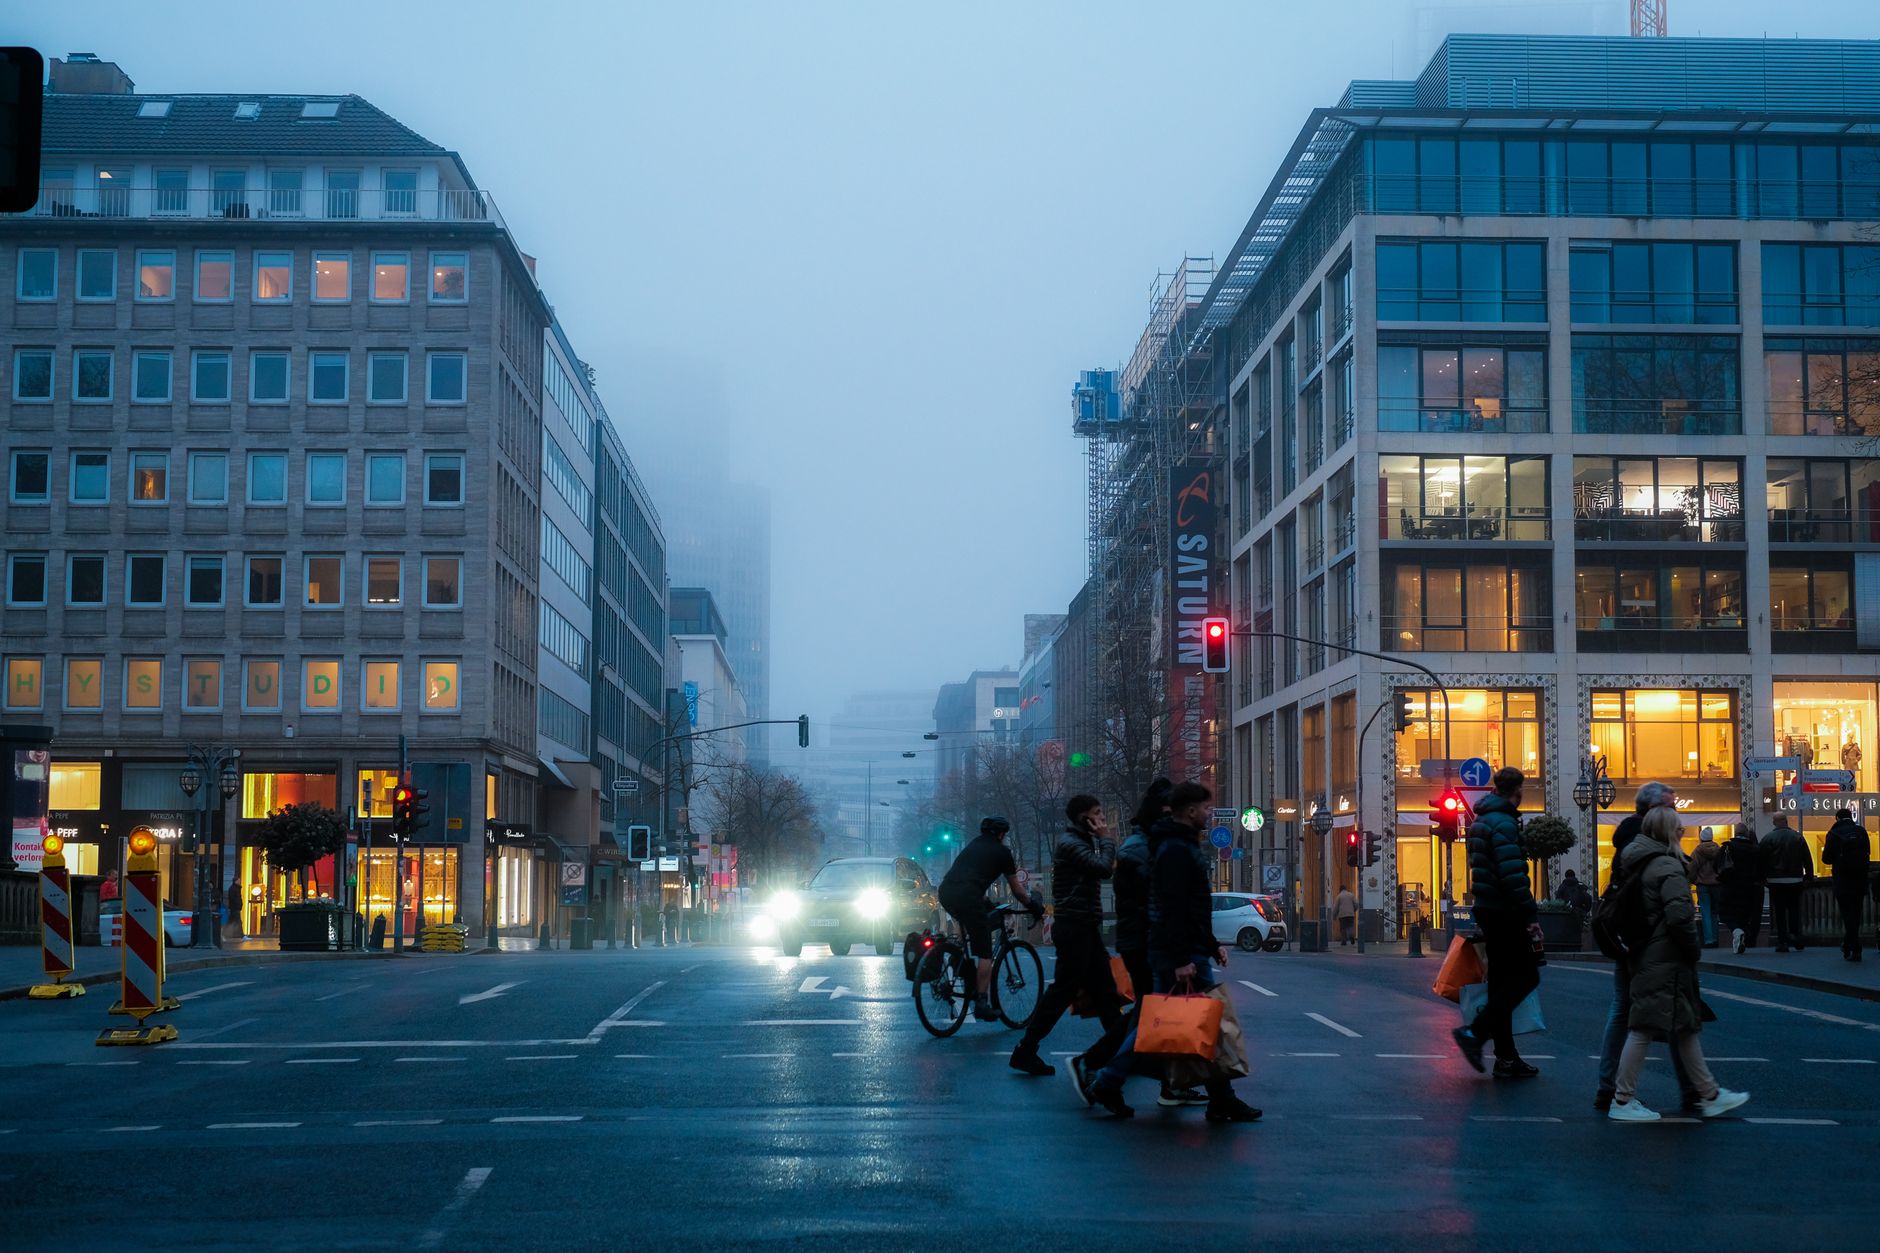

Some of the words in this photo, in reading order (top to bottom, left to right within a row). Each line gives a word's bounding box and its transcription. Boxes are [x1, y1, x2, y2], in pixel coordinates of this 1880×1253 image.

[1177, 534, 1208, 664] SATURN
[1779, 798, 1877, 810] LOGCHAP
[150, 812, 175, 820] PATRIZIA
[57, 828, 79, 838] PEPE
[14, 842, 43, 851] Kontak
